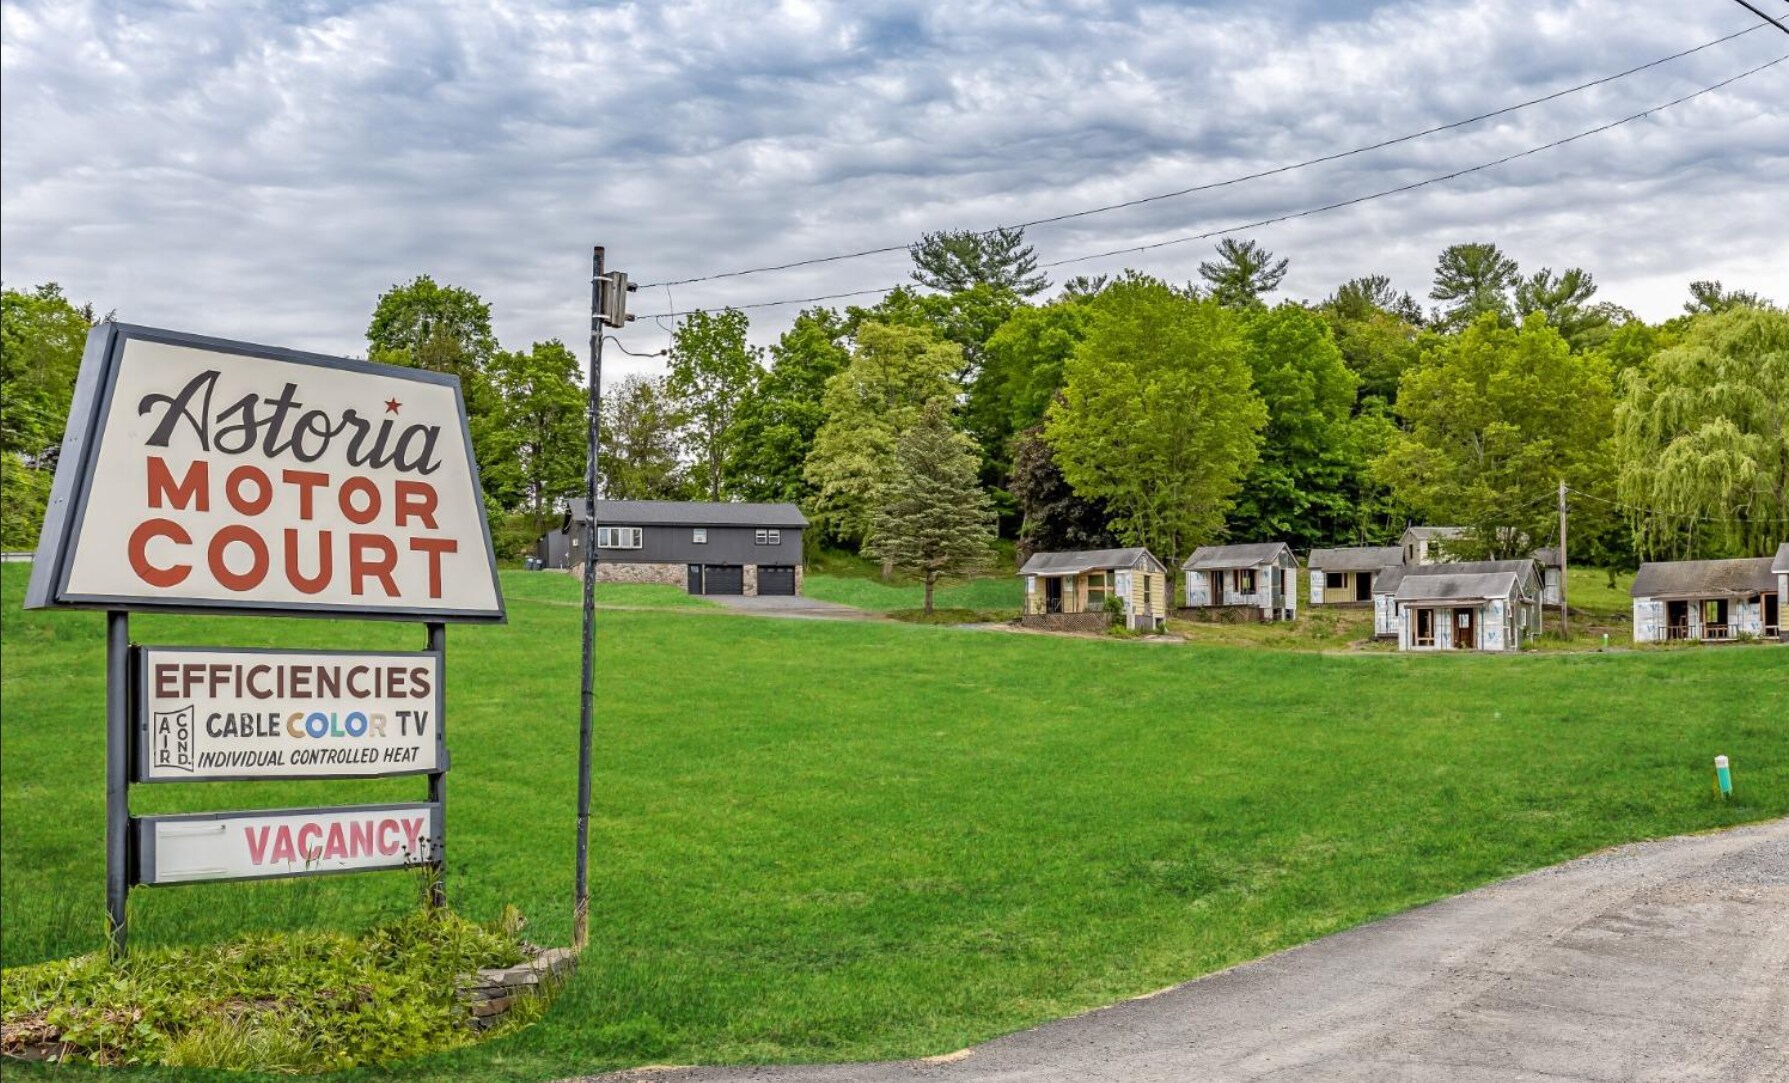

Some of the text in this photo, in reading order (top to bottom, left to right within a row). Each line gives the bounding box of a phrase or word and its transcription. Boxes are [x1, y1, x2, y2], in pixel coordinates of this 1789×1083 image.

[138, 370, 442, 476] Astoria
[146, 456, 439, 530] MOTOR
[127, 518, 458, 599] COURT
[155, 663, 431, 699] EFFICIENCIES
[158, 716, 171, 764] AIR
[206, 710, 429, 739] CABLE COLOR TV
[198, 746, 420, 769] INDIVIDUAL CONTROLLED HEAT
[244, 816, 425, 866] VACANCY
